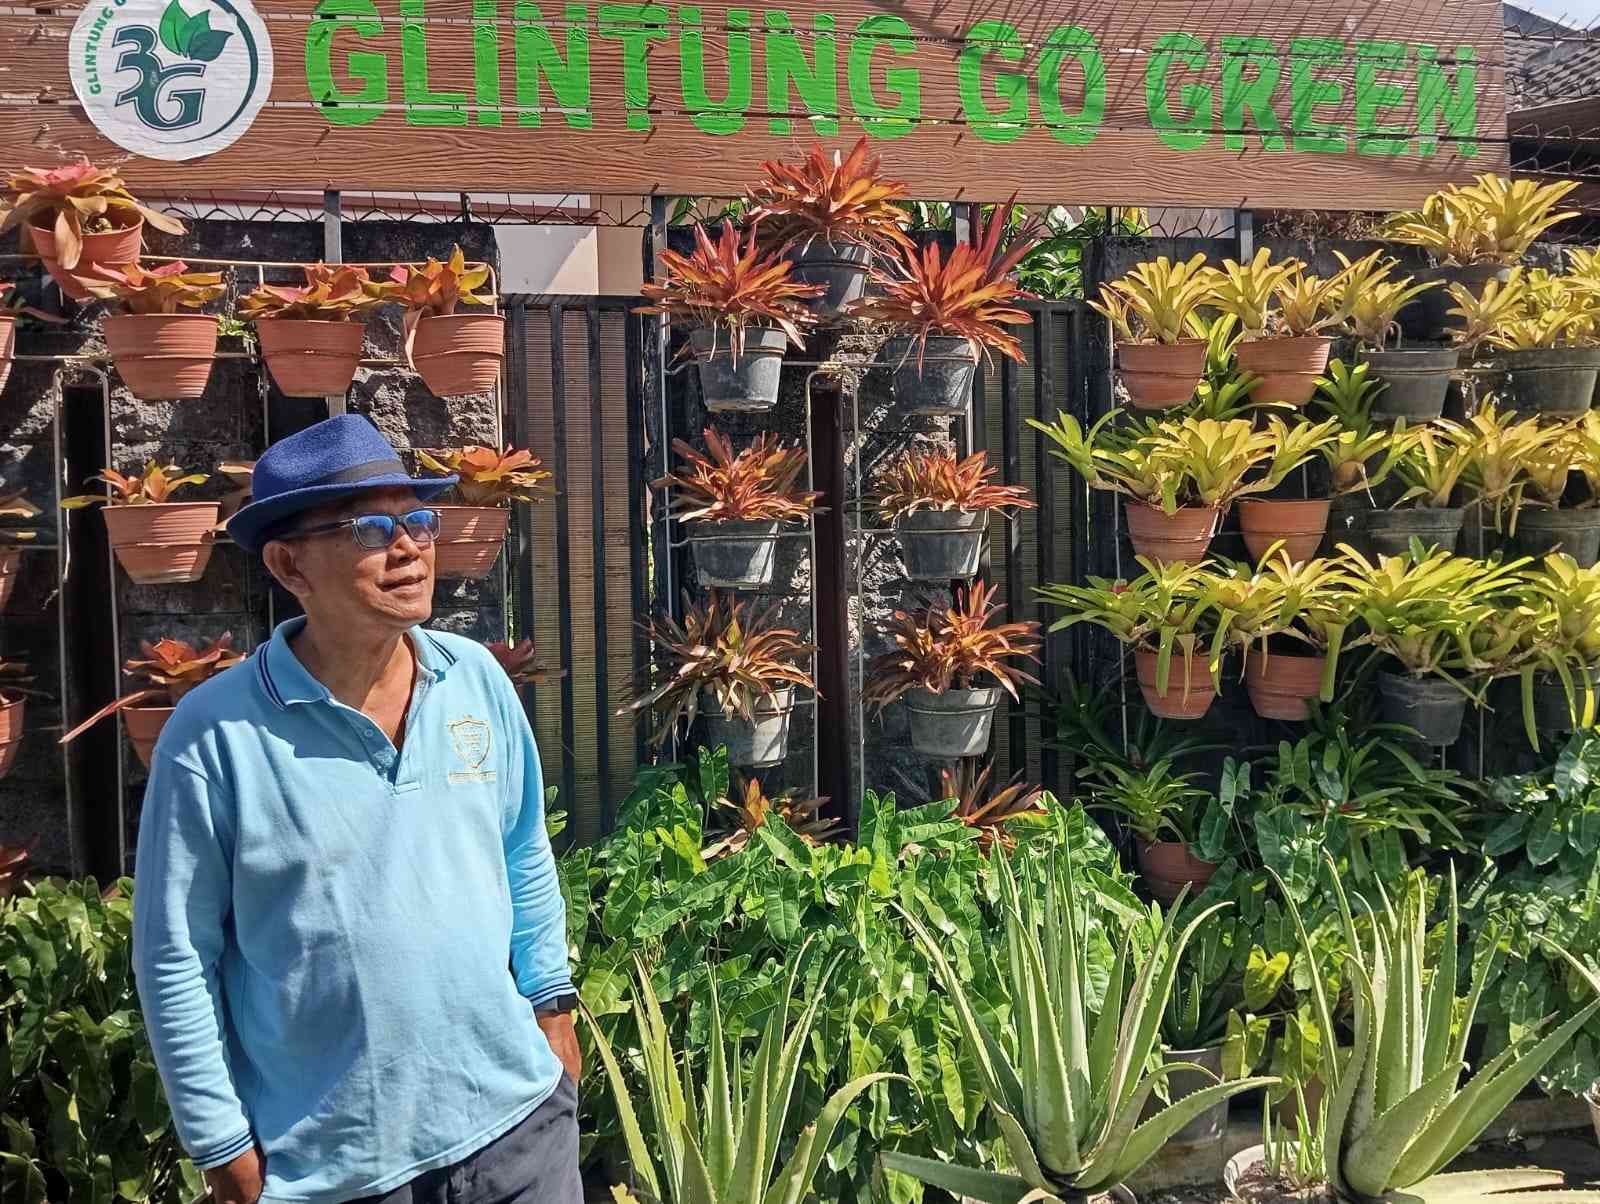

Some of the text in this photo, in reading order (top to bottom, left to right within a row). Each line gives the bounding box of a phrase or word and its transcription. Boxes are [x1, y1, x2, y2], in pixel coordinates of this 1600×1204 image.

[84, 6, 114, 95] GLINTUNG
[305, 0, 1479, 157] GLINTUNG GO GREEN
